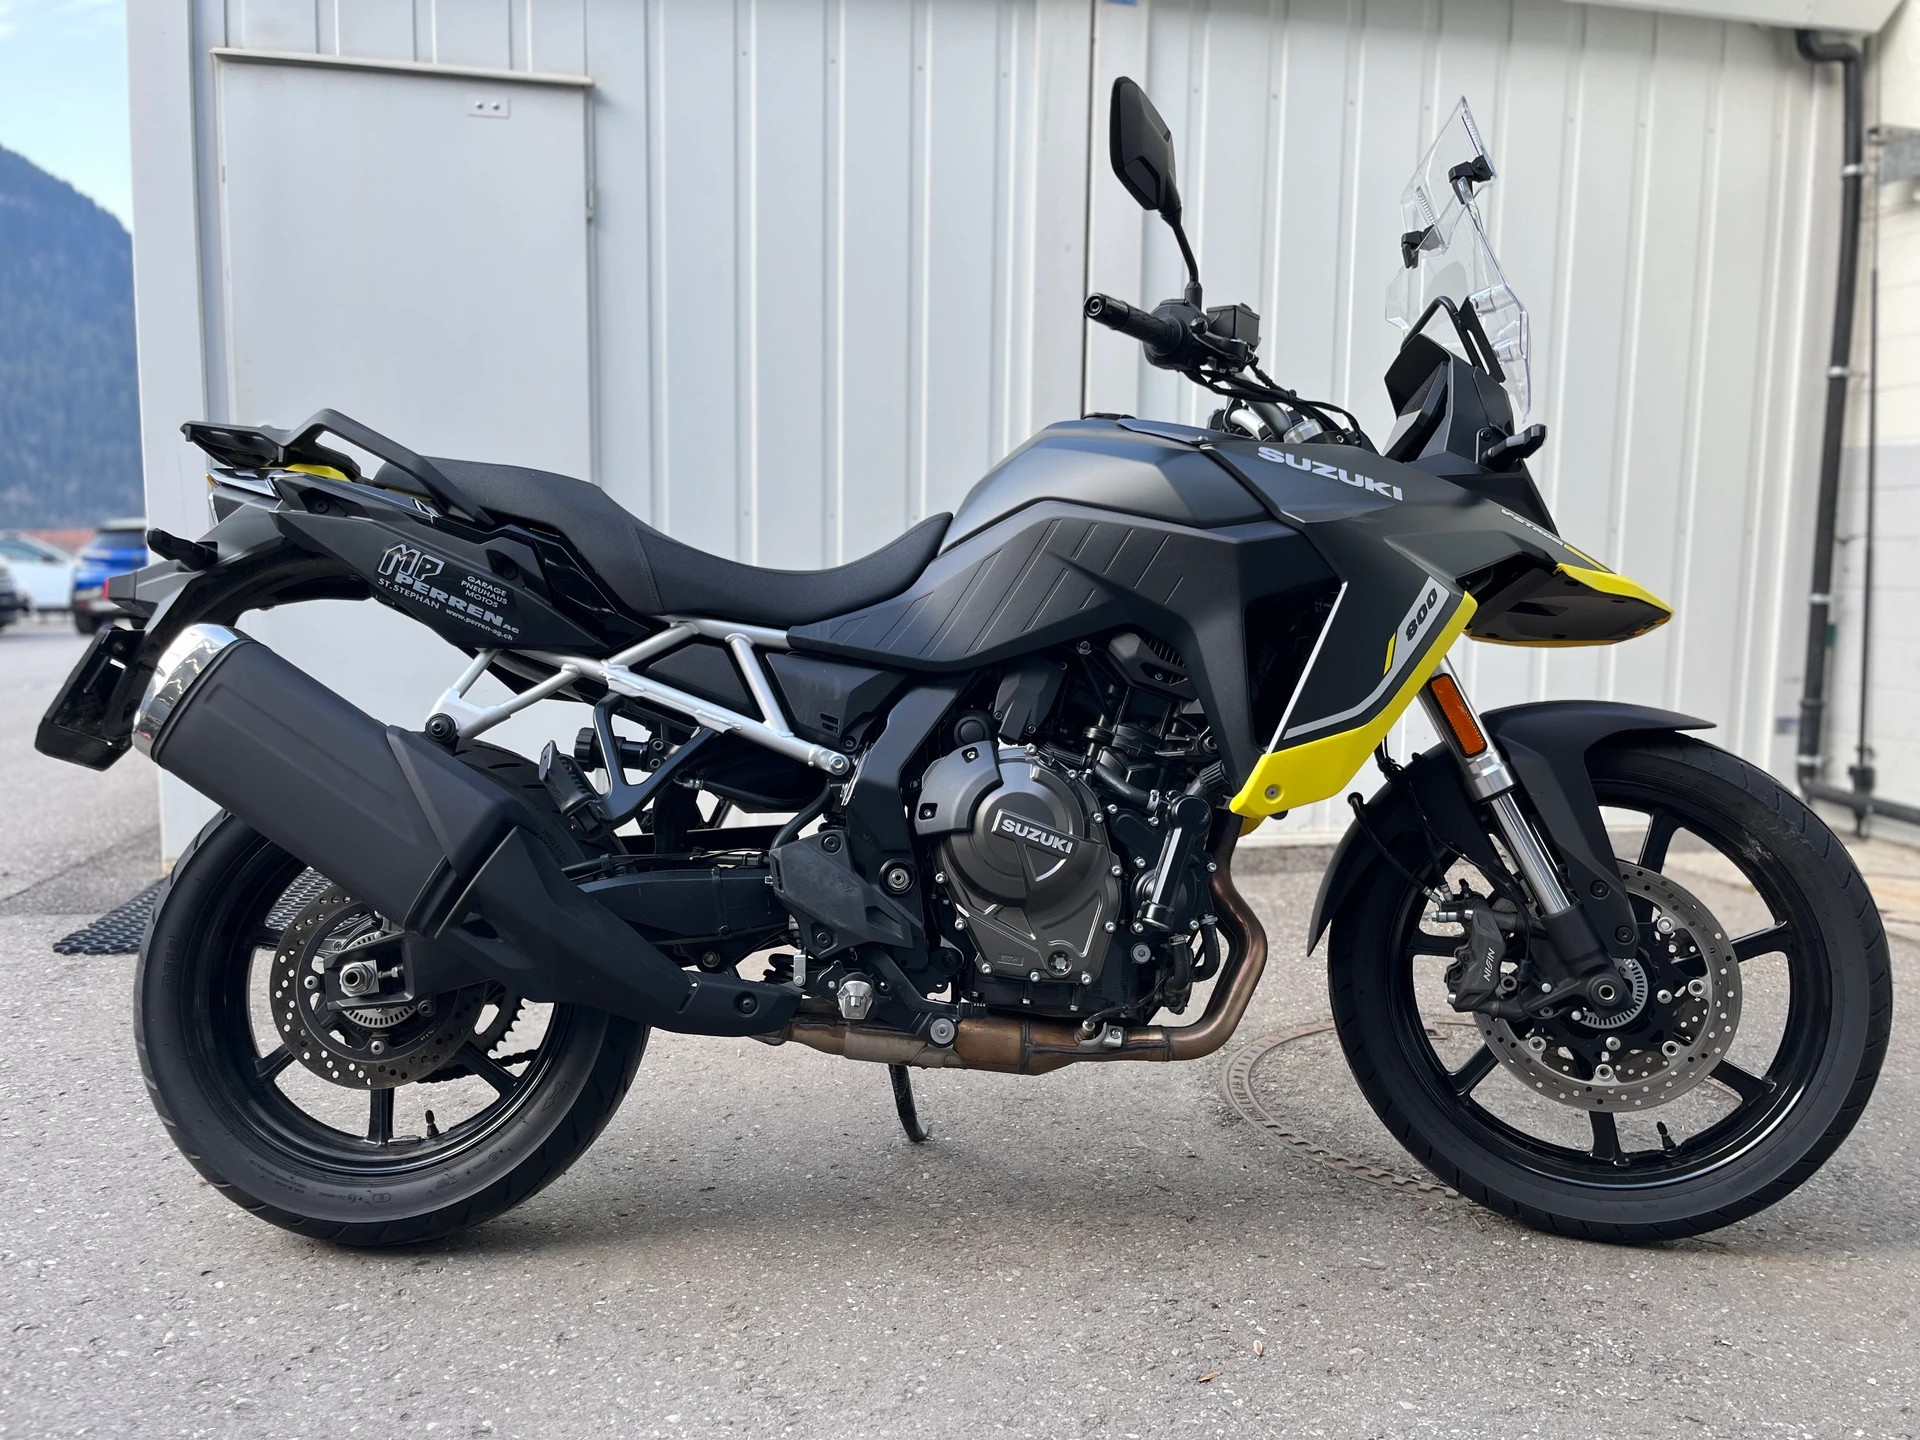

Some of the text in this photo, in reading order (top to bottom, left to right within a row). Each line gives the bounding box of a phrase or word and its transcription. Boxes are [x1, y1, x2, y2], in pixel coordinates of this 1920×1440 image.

[1258, 446, 1403, 502] SUZUKI
[377, 543, 445, 582] MP
[394, 572, 520, 634] PERREN AG
[461, 580, 508, 605] PNEUHAUS
[465, 589, 498, 608] MOTOS
[467, 575, 507, 598] GARAGE
[445, 608, 514, 642] www.perren-ag.ch
[1405, 587, 1438, 642] 800
[1001, 818, 1074, 854] SUZUKI
